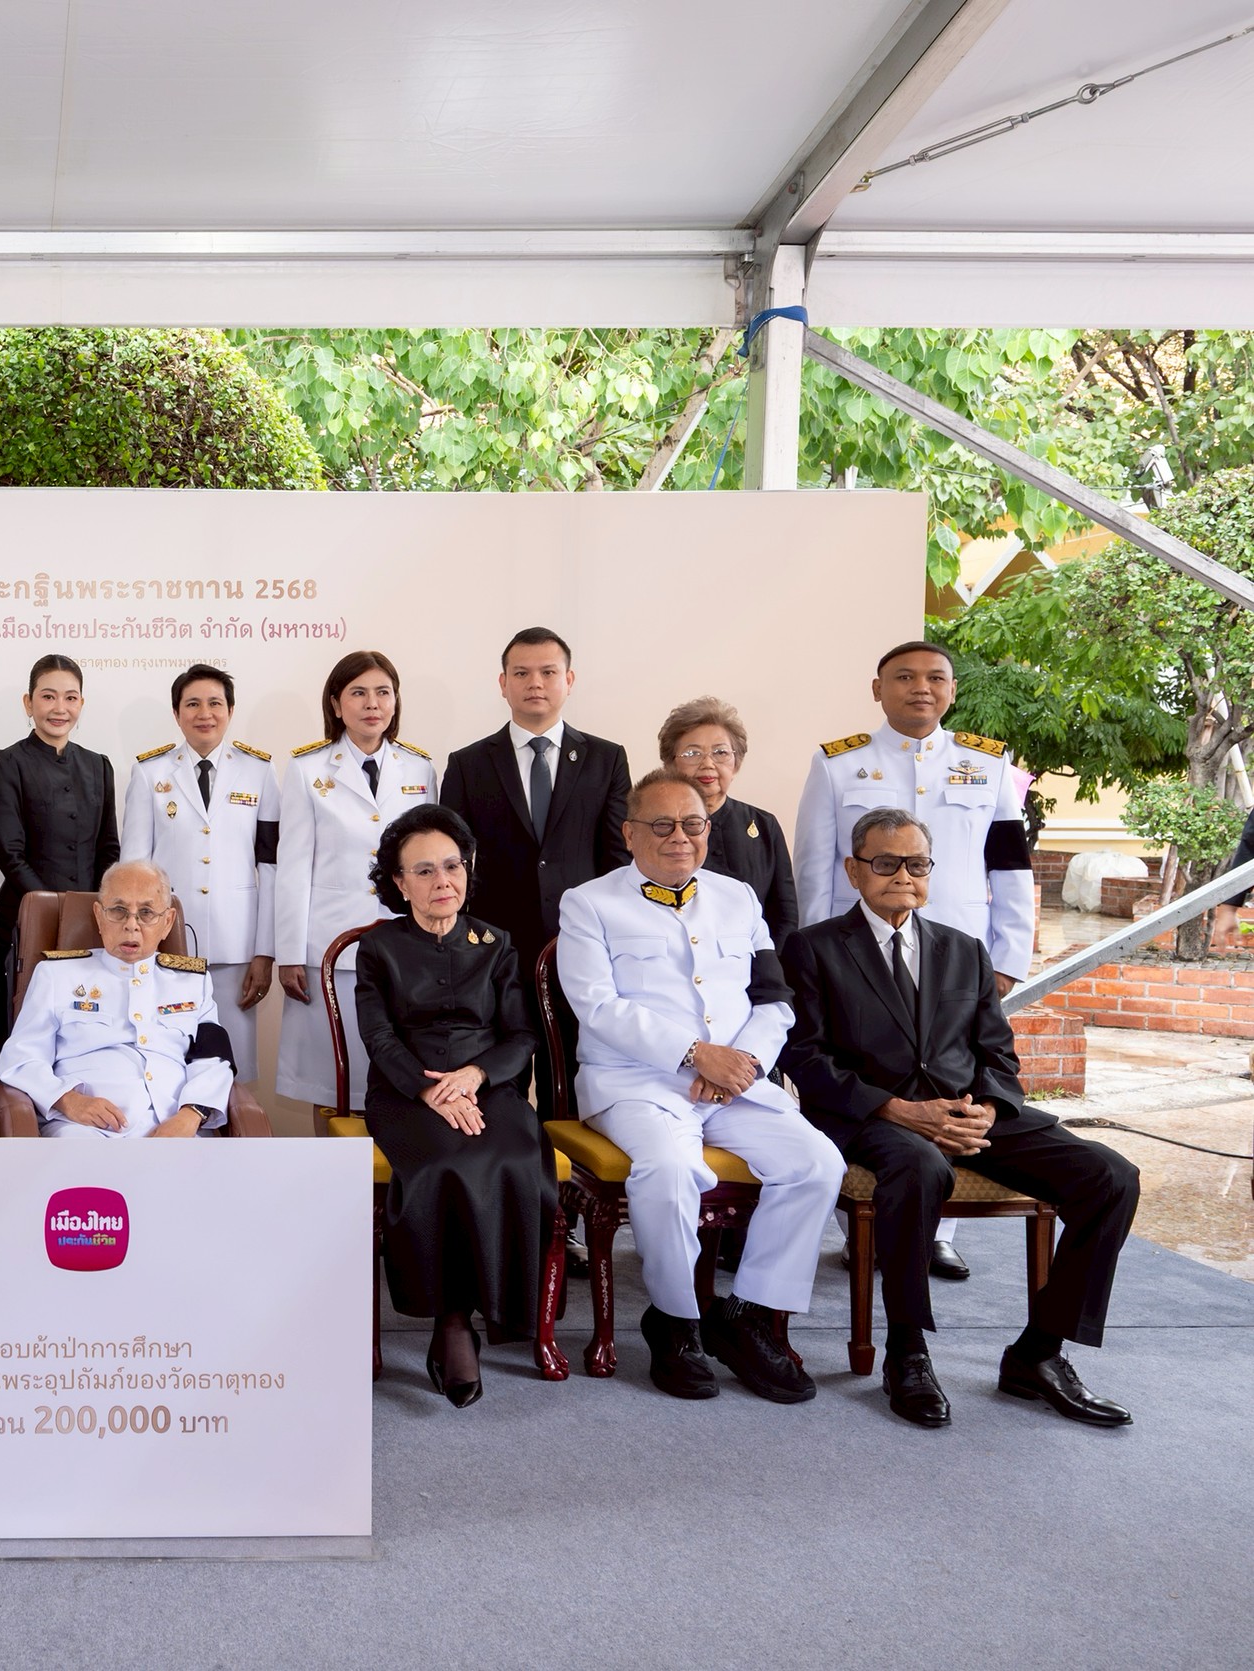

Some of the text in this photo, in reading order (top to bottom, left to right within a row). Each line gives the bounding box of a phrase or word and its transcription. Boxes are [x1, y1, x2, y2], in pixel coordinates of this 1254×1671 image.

[255, 578, 318, 600] 2568
[199, 616, 254, 639] จำกัด
[260, 616, 348, 643] (มหาชน)
[50, 1209, 123, 1231] เมืองไทย
[57, 1232, 117, 1246] ประกันชีวิต
[33, 1405, 172, 1440] 200,000
[179, 1414, 229, 1434] บาท
